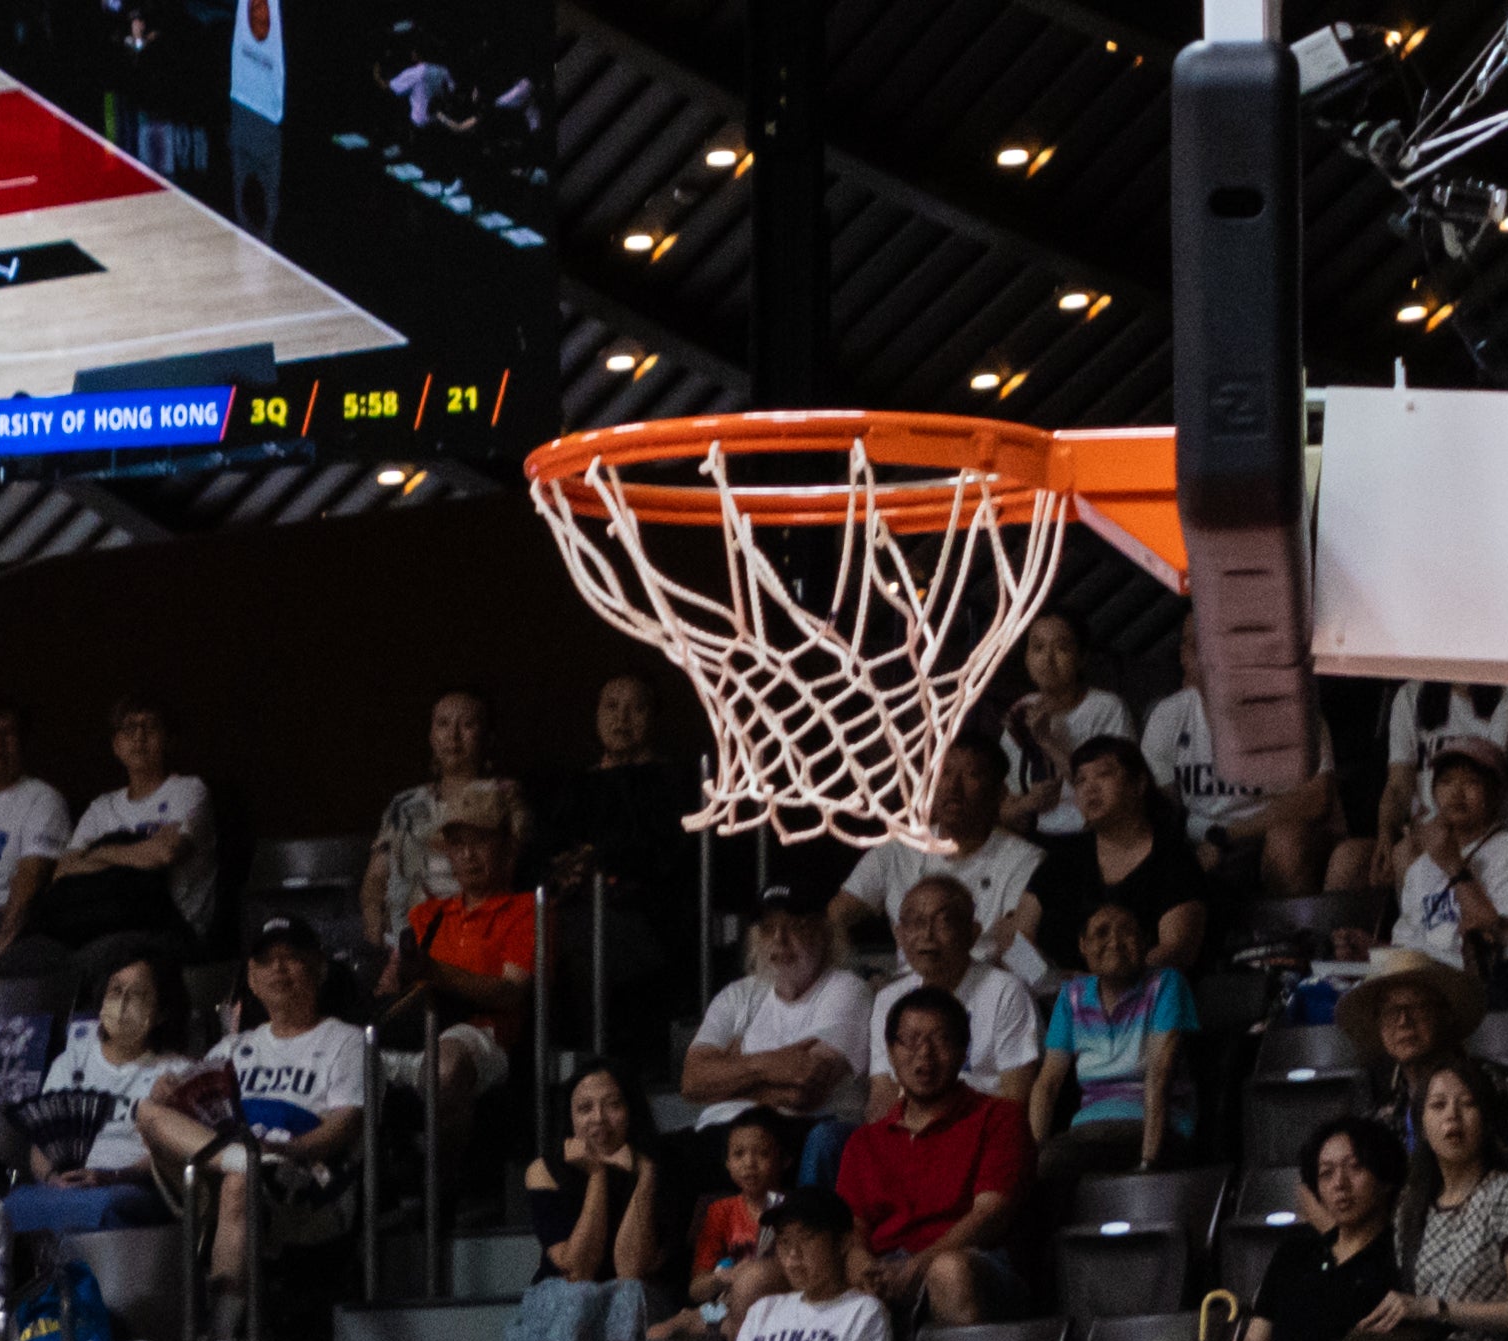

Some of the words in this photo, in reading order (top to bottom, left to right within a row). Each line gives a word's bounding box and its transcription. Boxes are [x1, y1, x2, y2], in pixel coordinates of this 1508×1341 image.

[250, 398, 288, 428] 3Q
[343, 392, 400, 420] 5:58
[446, 386, 478, 413] 21
[61, 408, 87, 434] OF
[94, 405, 153, 432] HONG
[160, 401, 219, 429] KONG
